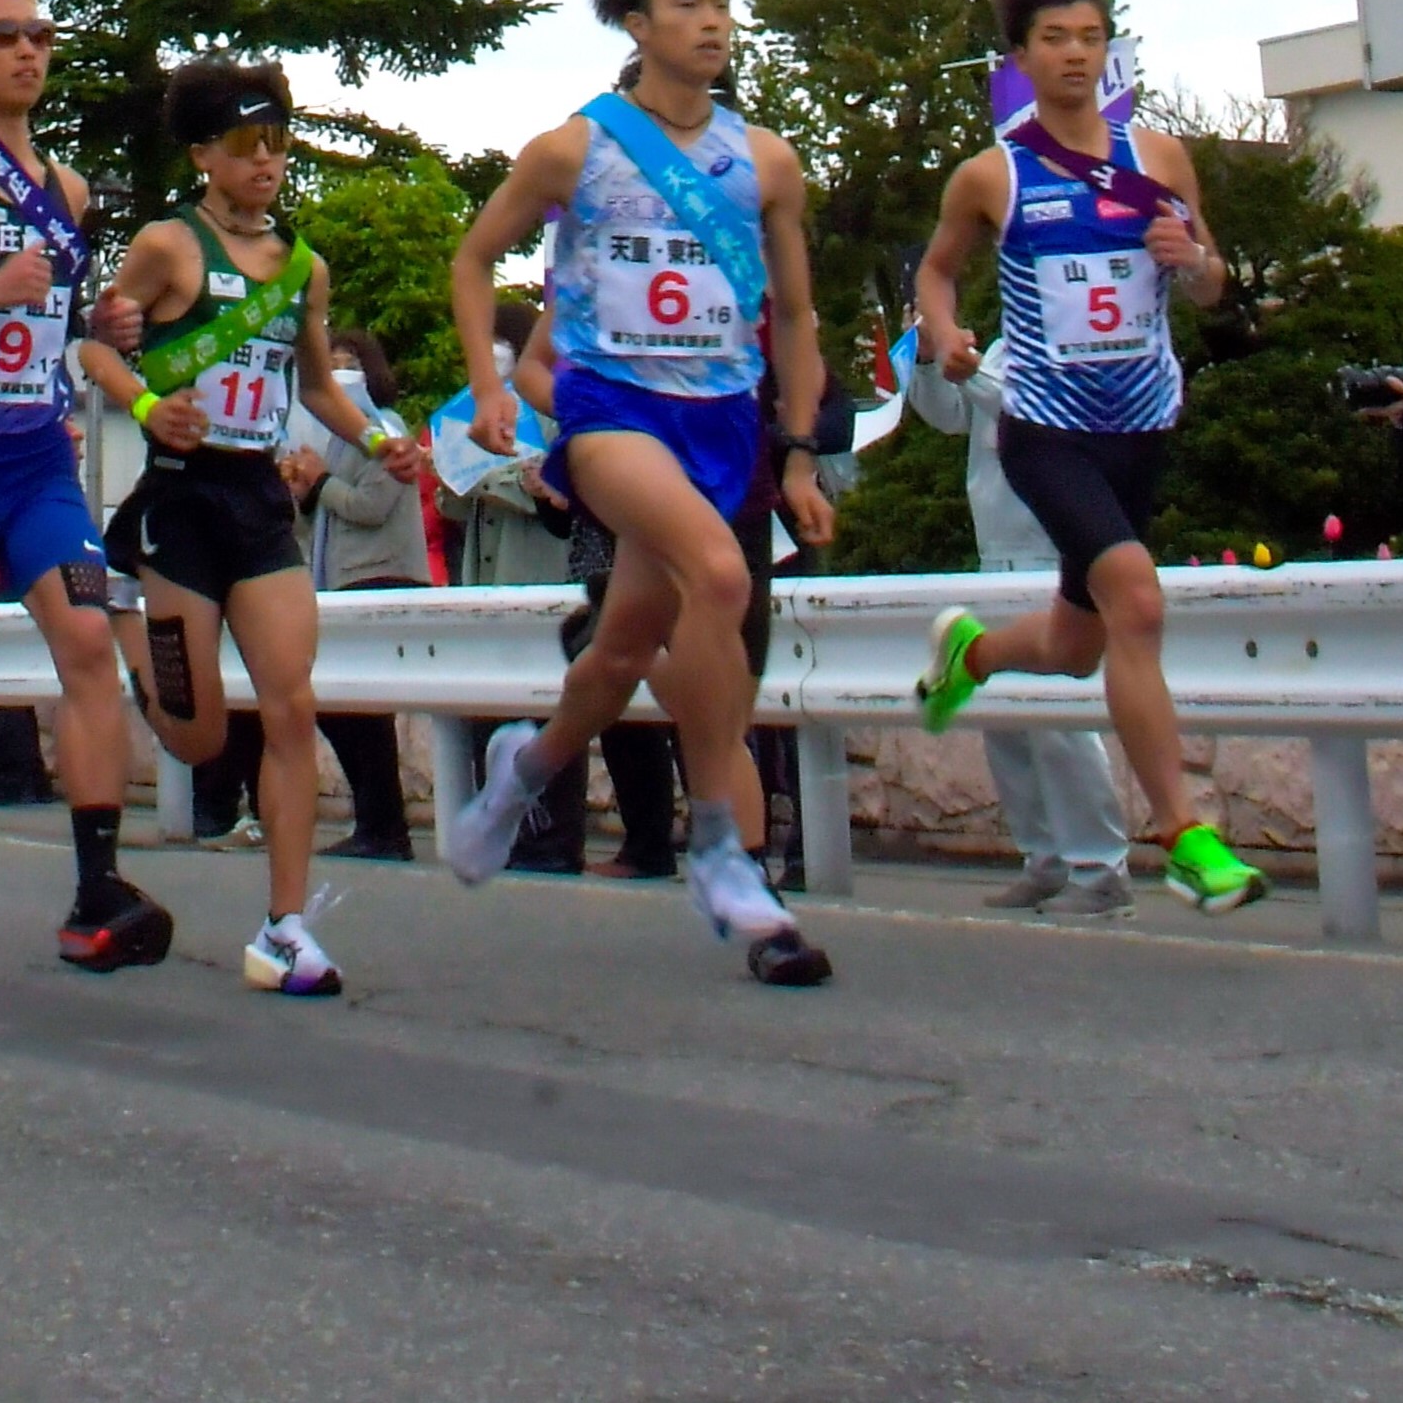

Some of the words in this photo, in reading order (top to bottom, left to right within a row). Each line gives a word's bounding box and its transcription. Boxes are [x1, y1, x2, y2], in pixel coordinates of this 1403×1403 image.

[610, 234, 717, 265] 天童・東村
[1062, 257, 1133, 283] 山形
[648, 270, 691, 325] 6
[1088, 286, 1122, 333] 5
[220, 371, 265, 421] 11
